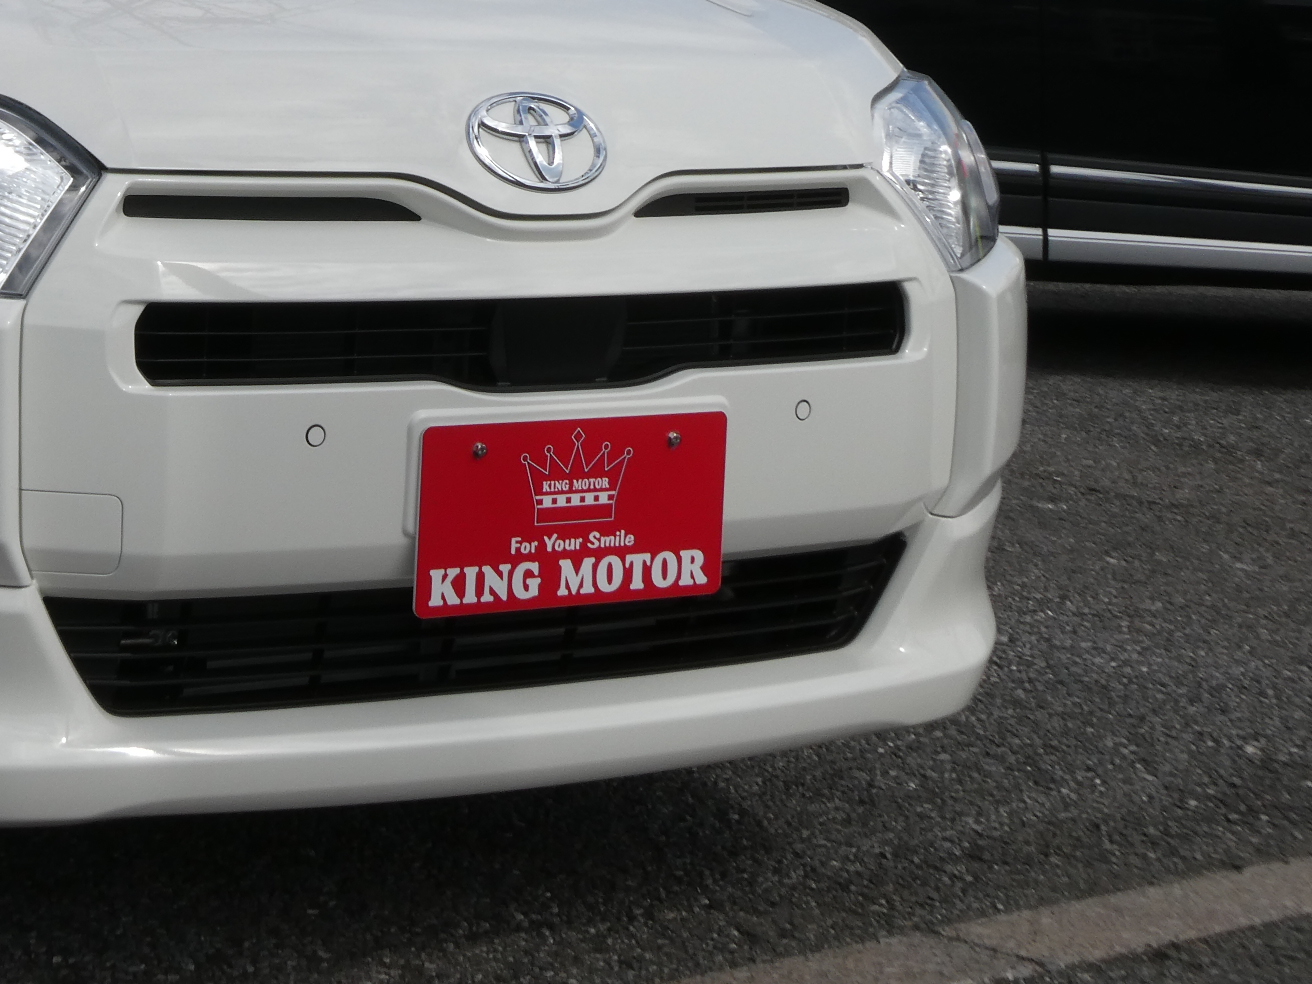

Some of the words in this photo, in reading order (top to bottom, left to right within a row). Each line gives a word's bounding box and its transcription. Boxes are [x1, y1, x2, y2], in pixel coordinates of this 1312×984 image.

[542, 479, 570, 493] KING
[572, 476, 610, 491] MOTOR
[510, 536, 538, 555] For
[544, 532, 583, 552] Your
[587, 530, 635, 549] Smile
[428, 561, 541, 608] KING
[557, 548, 708, 597] MOTOR
